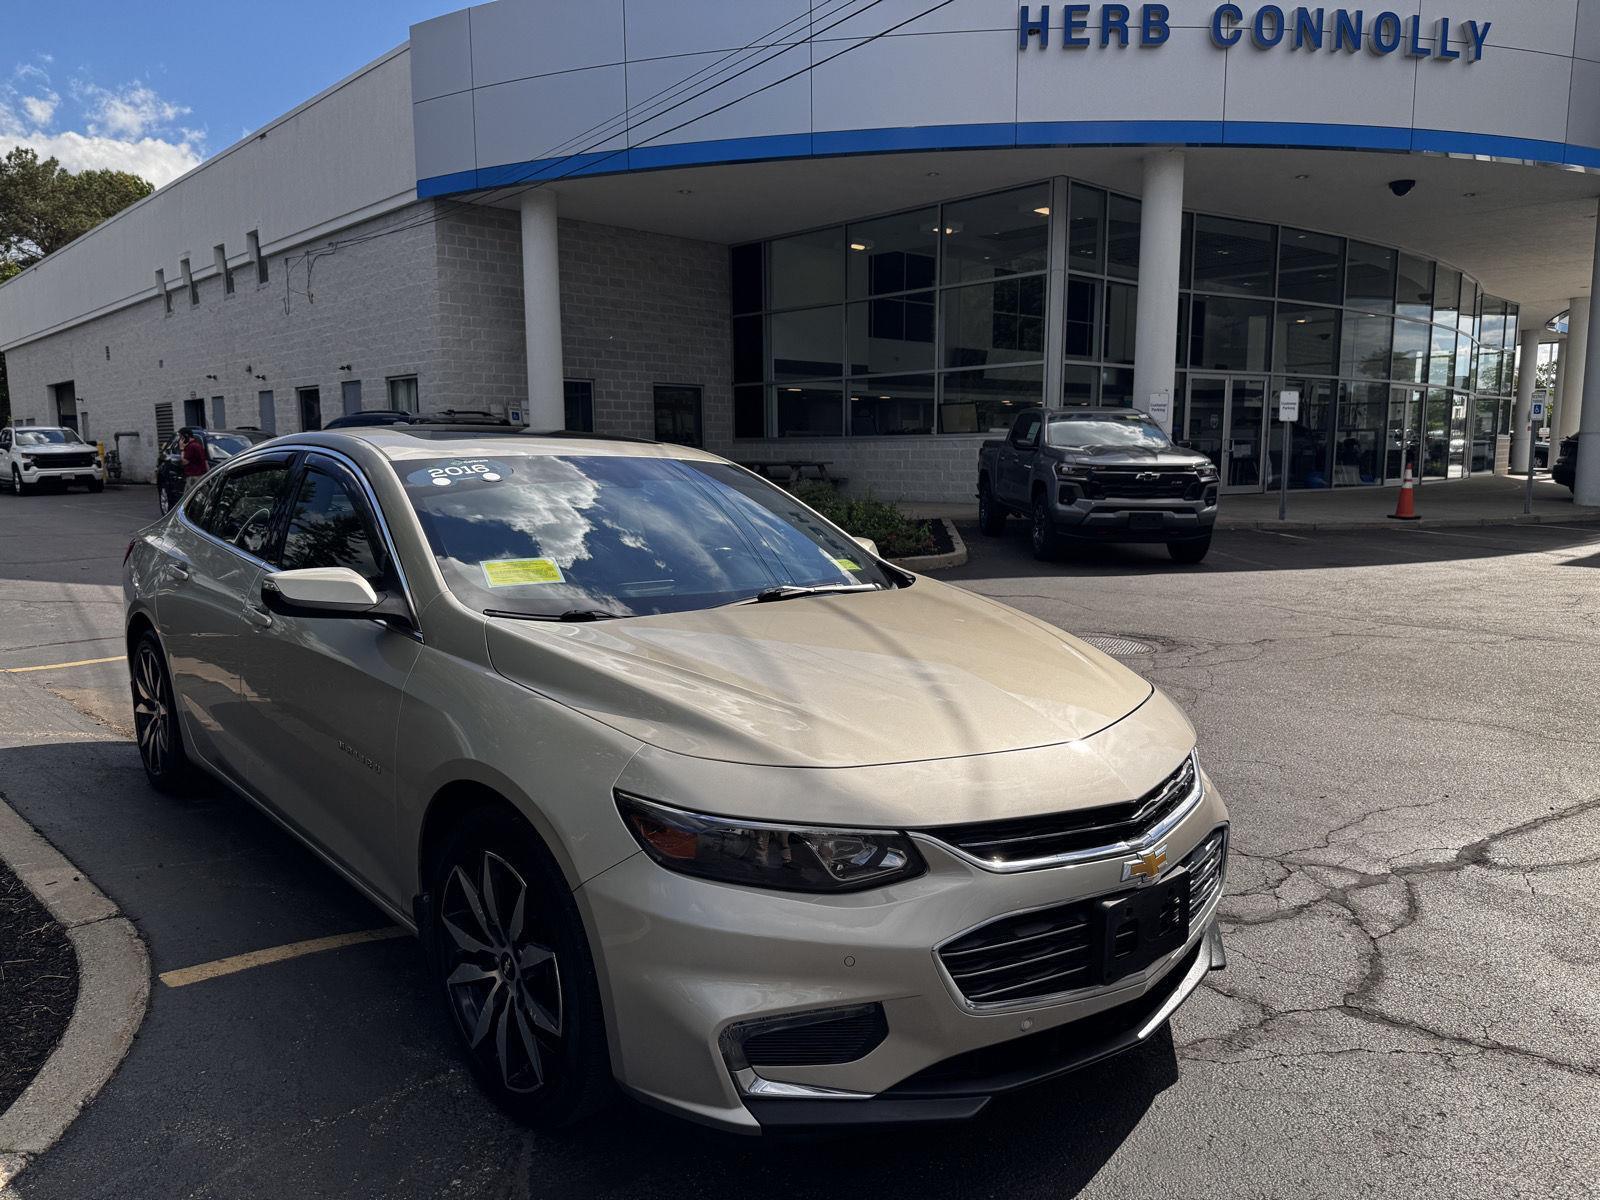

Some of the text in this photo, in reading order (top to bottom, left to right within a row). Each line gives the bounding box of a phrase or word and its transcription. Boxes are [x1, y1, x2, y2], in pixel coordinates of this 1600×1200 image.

[1020, 4, 1491, 62] HERB CONNOLLY
[427, 464, 490, 478] 2016
